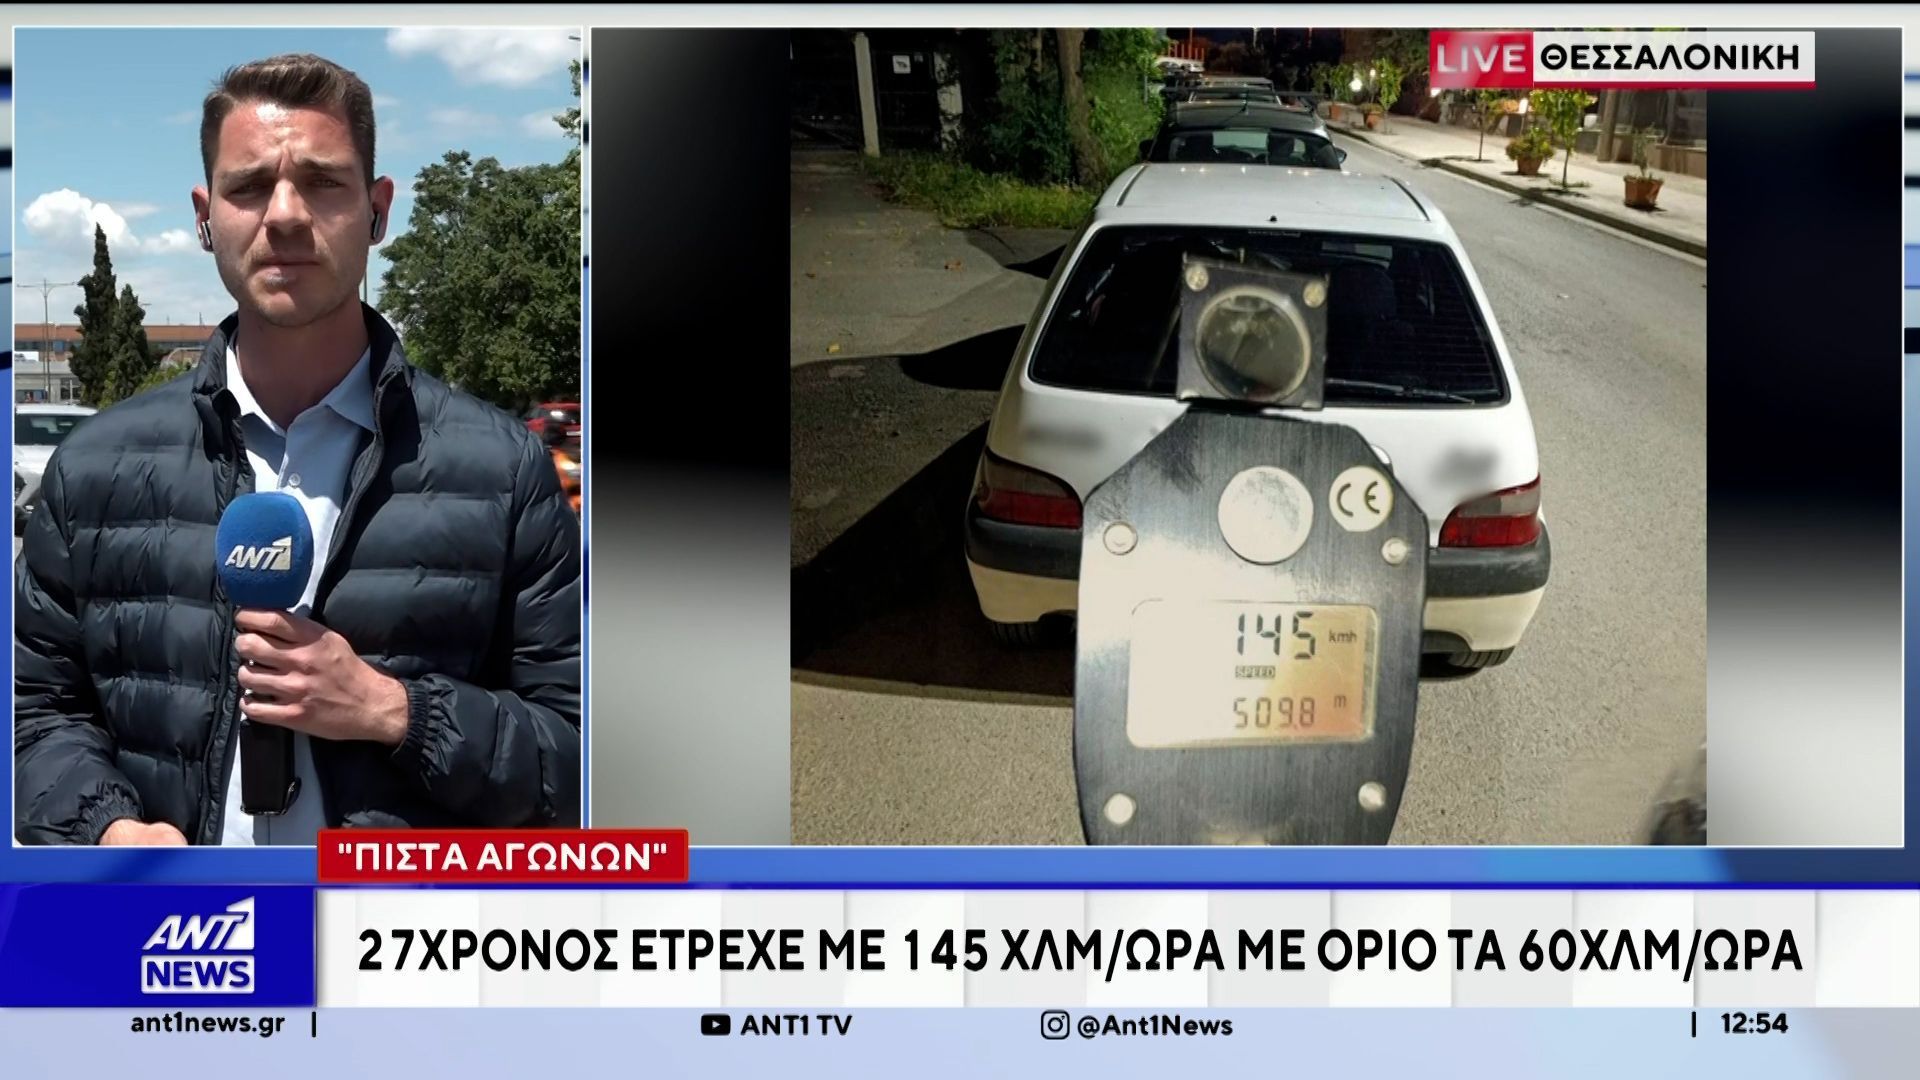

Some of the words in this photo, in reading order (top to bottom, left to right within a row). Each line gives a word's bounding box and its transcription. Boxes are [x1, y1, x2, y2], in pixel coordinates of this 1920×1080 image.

[1336, 481, 1380, 517] CE
[1237, 611, 1316, 660] 145
[1328, 629, 1358, 643] kmh
[1236, 666, 1275, 678] SPEED
[1333, 695, 1347, 708] m
